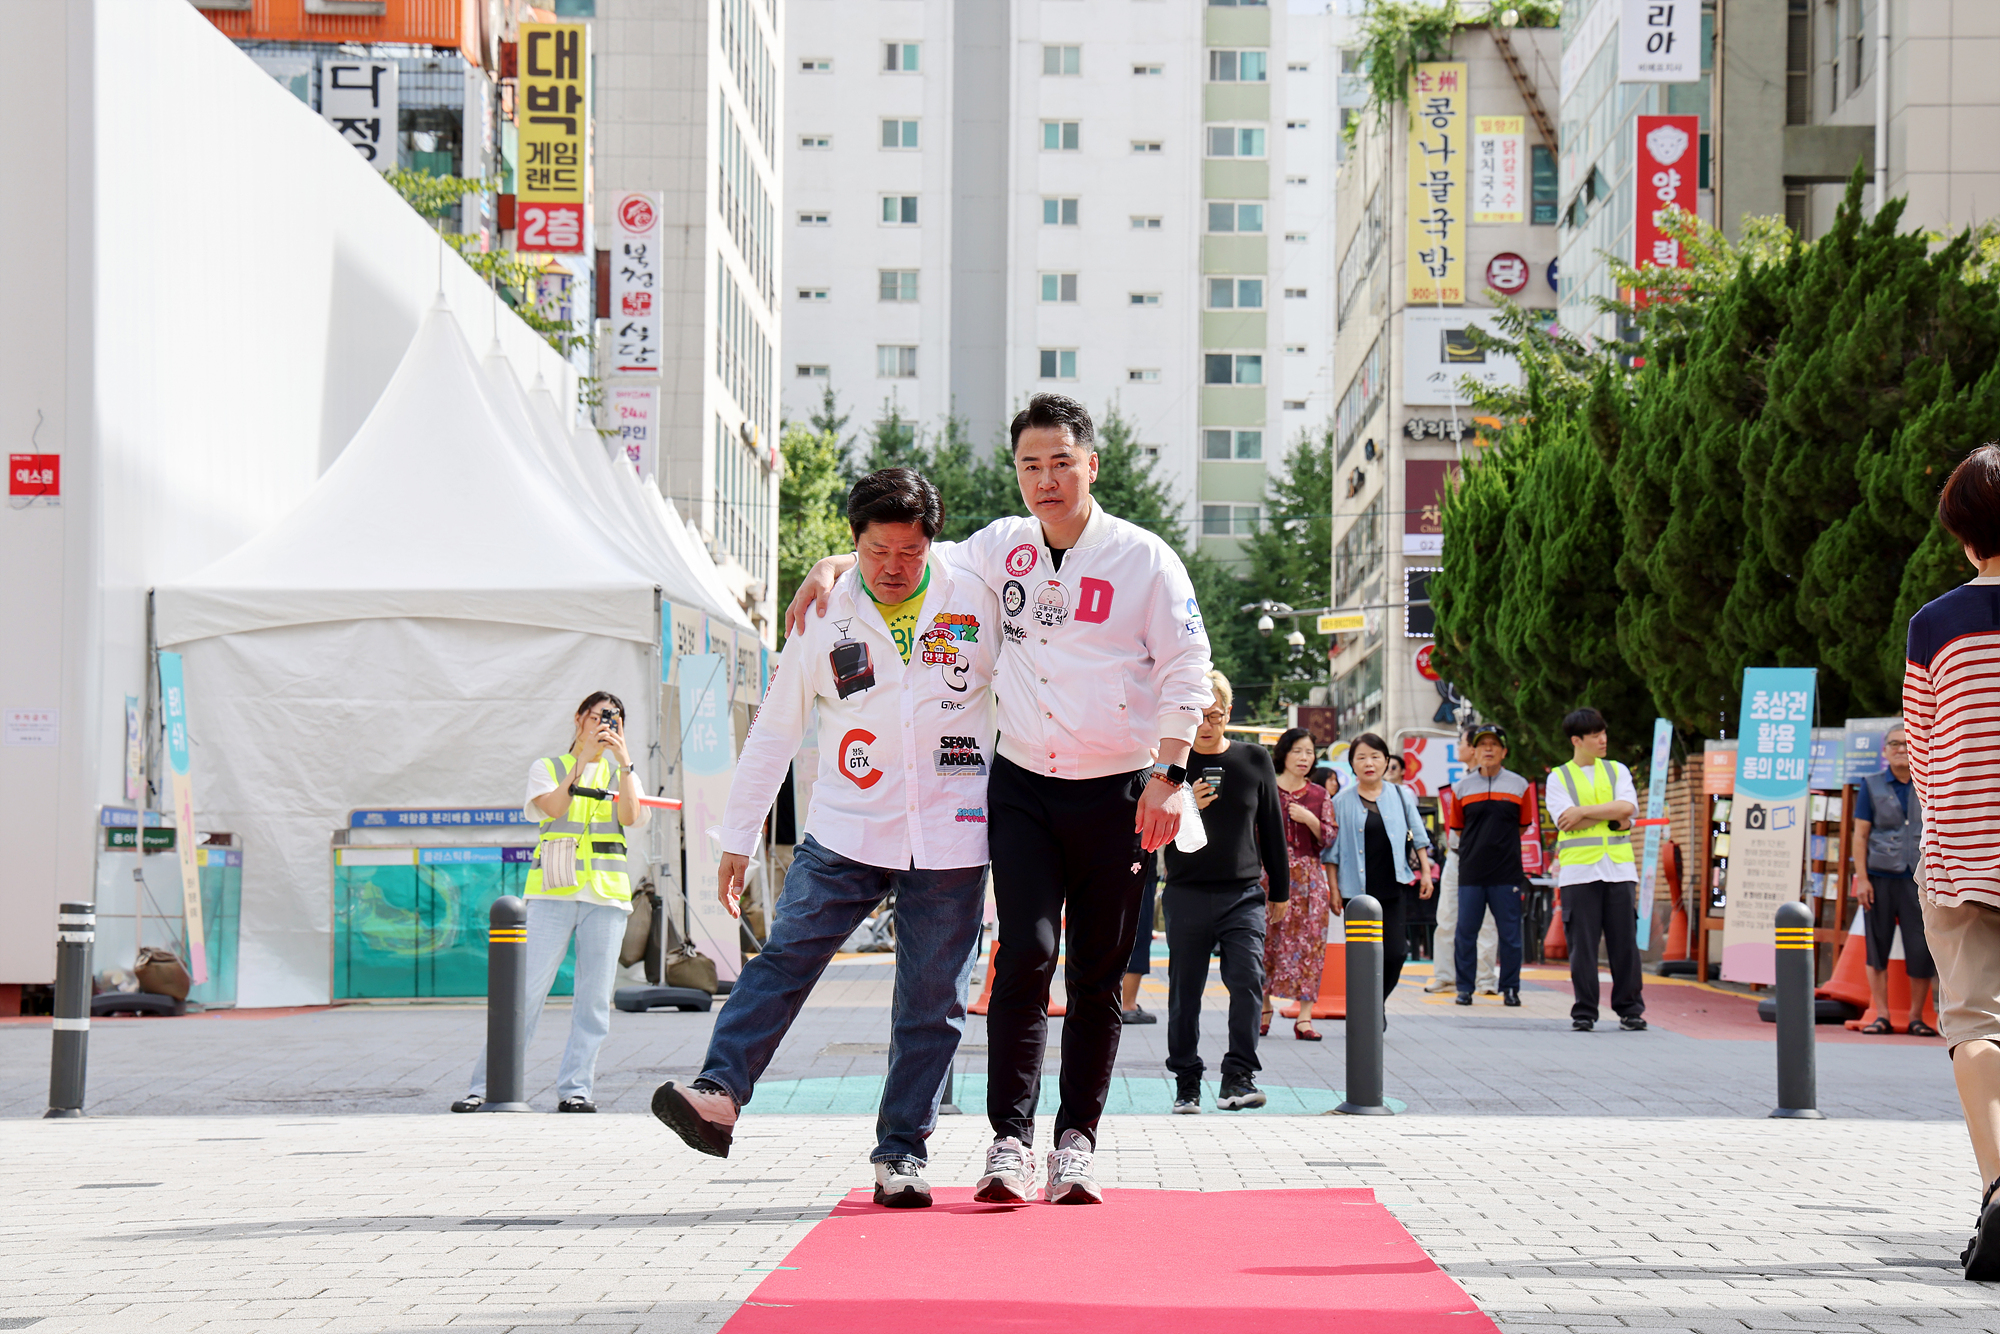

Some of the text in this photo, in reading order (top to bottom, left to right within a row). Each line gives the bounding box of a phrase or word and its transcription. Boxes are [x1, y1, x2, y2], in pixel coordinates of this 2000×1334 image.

[527, 30, 583, 135] 대박
[526, 142, 577, 166] 게임
[526, 168, 577, 191] 랜드
[1480, 139, 1495, 209] 멸치국수
[1418, 97, 1457, 279] 콩나물국밥
[523, 207, 579, 247] 2층
[15, 468, 54, 484] 에스원
[1073, 576, 1115, 625] D
[933, 613, 981, 628] SEOUL
[1750, 690, 1807, 721] 초상권
[940, 735, 980, 750] SEOUL
[1757, 722, 1796, 753] 활용
[850, 756, 870, 769] GTX
[939, 752, 986, 766] ARENA
[1743, 757, 1772, 779] 동의
[1775, 757, 1805, 780] 안내
[474, 811, 505, 823] 나부터
